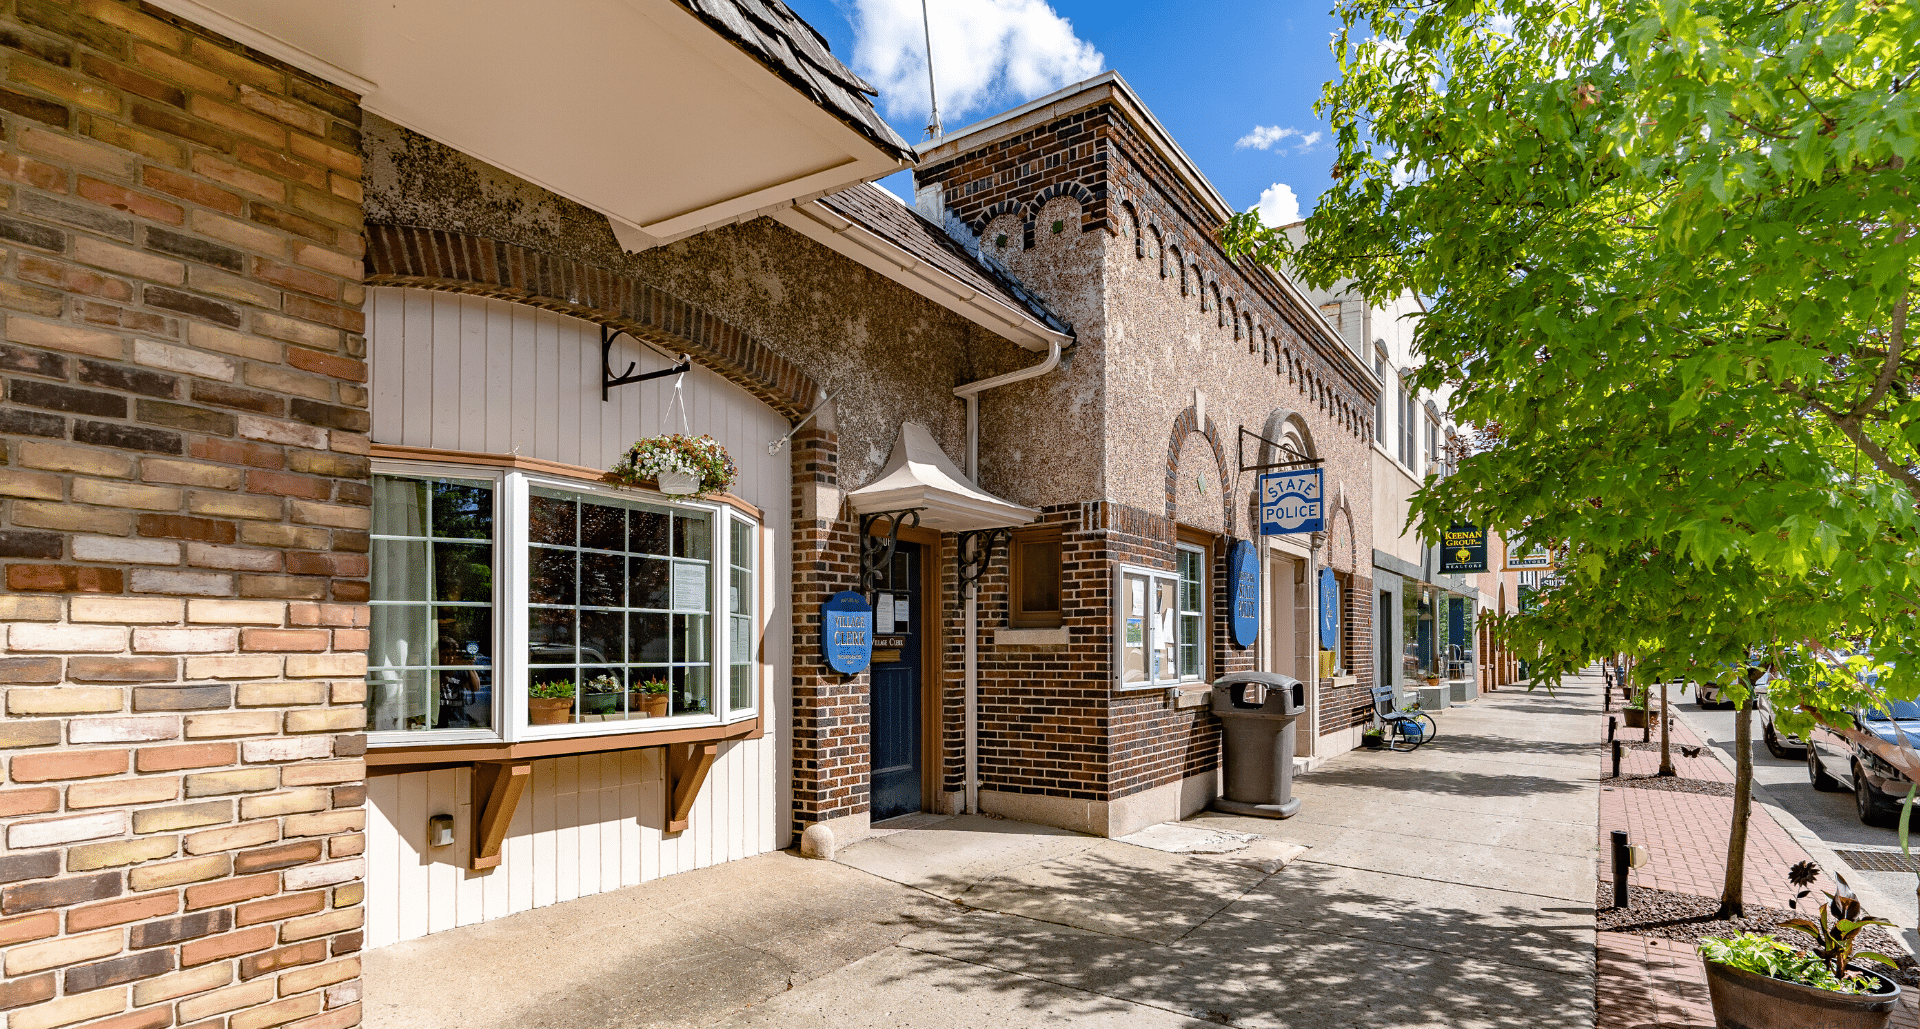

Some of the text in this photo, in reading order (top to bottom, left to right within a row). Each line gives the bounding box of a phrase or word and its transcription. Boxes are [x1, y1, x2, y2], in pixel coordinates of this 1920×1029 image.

[1268, 479, 1315, 498] STATE
[1266, 504, 1317, 520] POLICE
[1444, 531, 1482, 540] KEENAN
[835, 616, 865, 628] VILLAGE
[834, 631, 865, 646] CLERK
